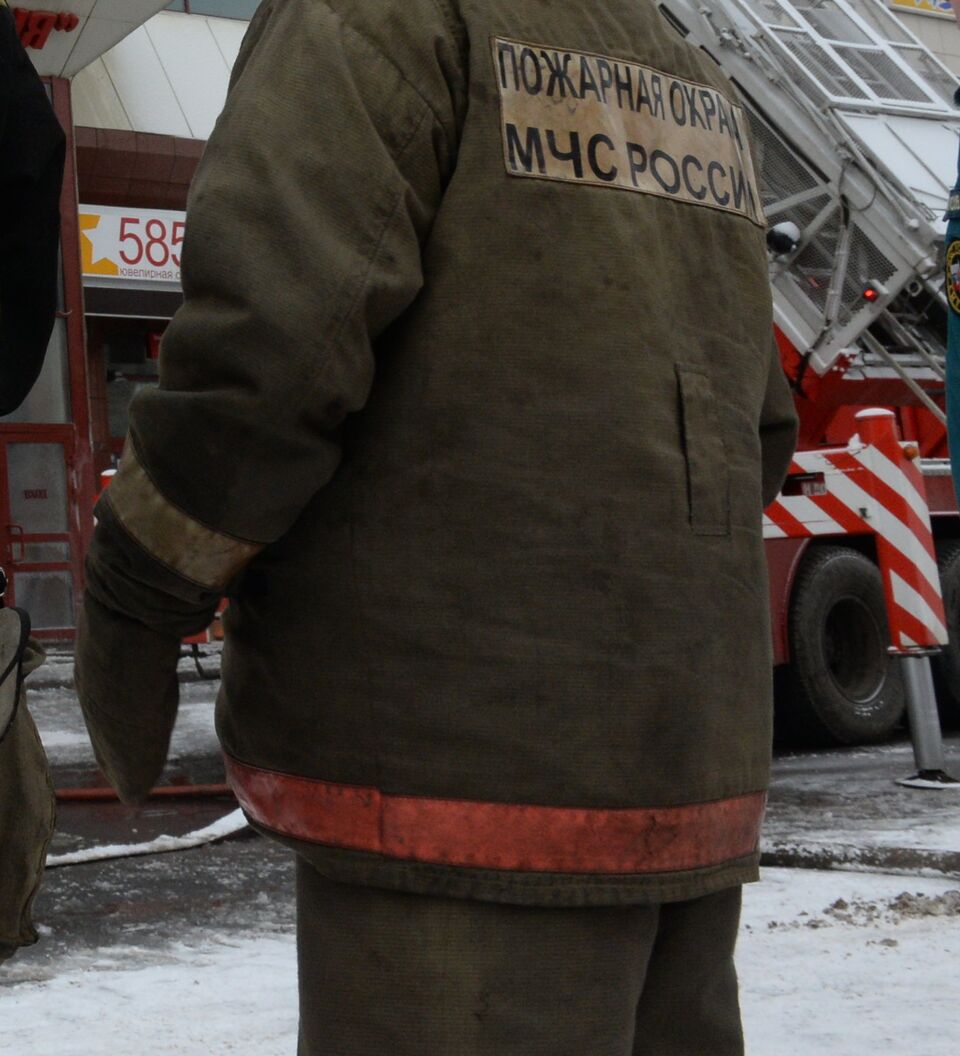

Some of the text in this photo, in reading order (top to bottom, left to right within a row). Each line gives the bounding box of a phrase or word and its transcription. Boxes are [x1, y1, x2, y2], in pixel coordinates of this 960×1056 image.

[497, 44, 666, 121] ПОЖАРНАЯ
[505, 123, 618, 182] МЧС
[119, 267, 174, 281] ювелирная
